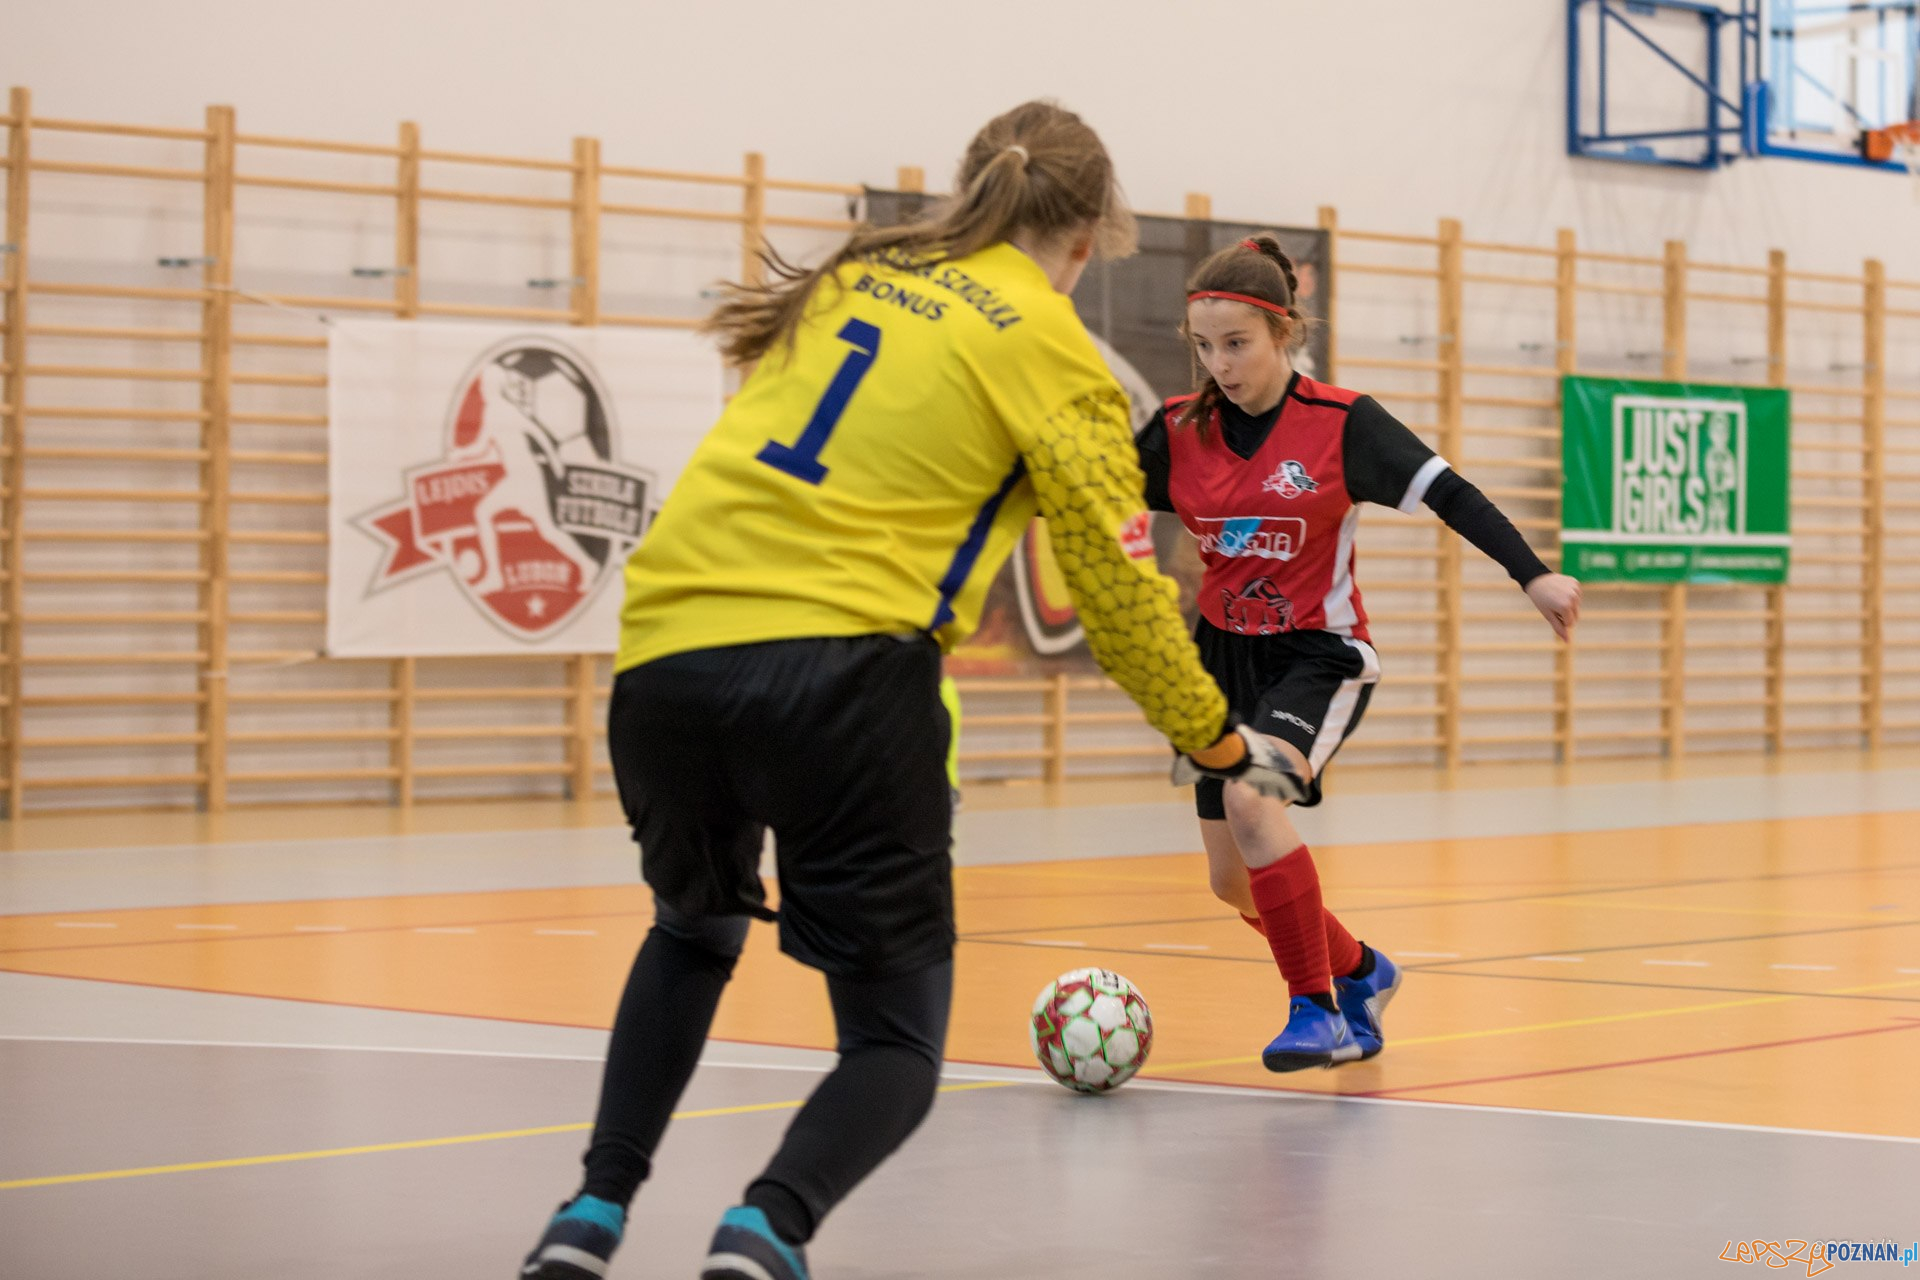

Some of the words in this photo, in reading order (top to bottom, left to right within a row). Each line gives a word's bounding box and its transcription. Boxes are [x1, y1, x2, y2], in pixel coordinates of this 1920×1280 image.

[853, 274, 950, 321] BONUS
[754, 317, 882, 485] 1
[1624, 409, 1704, 476] JUST
[1624, 475, 1705, 535] GIRLS
